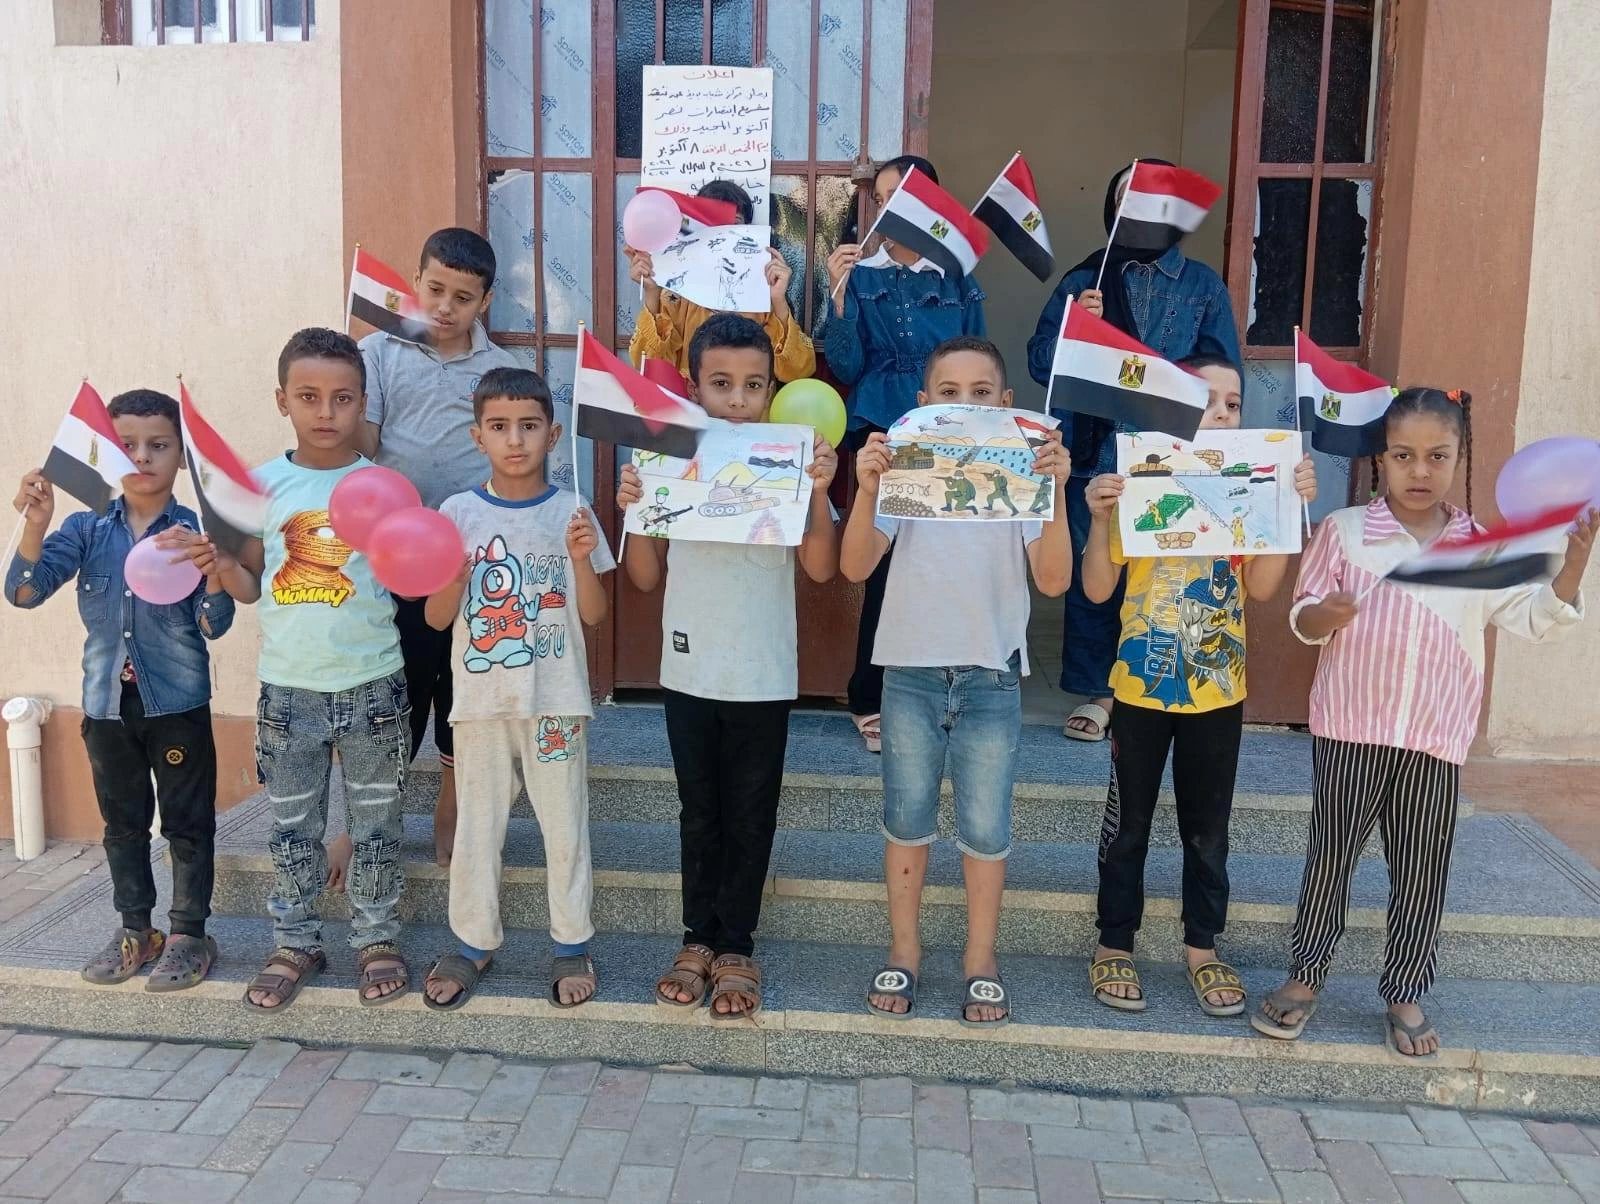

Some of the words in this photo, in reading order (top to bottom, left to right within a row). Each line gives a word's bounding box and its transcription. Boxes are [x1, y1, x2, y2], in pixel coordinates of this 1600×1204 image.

[550, 173, 577, 203] Spirton
[550, 257, 578, 288] Spirton
[272, 587, 350, 608] MUMMY
